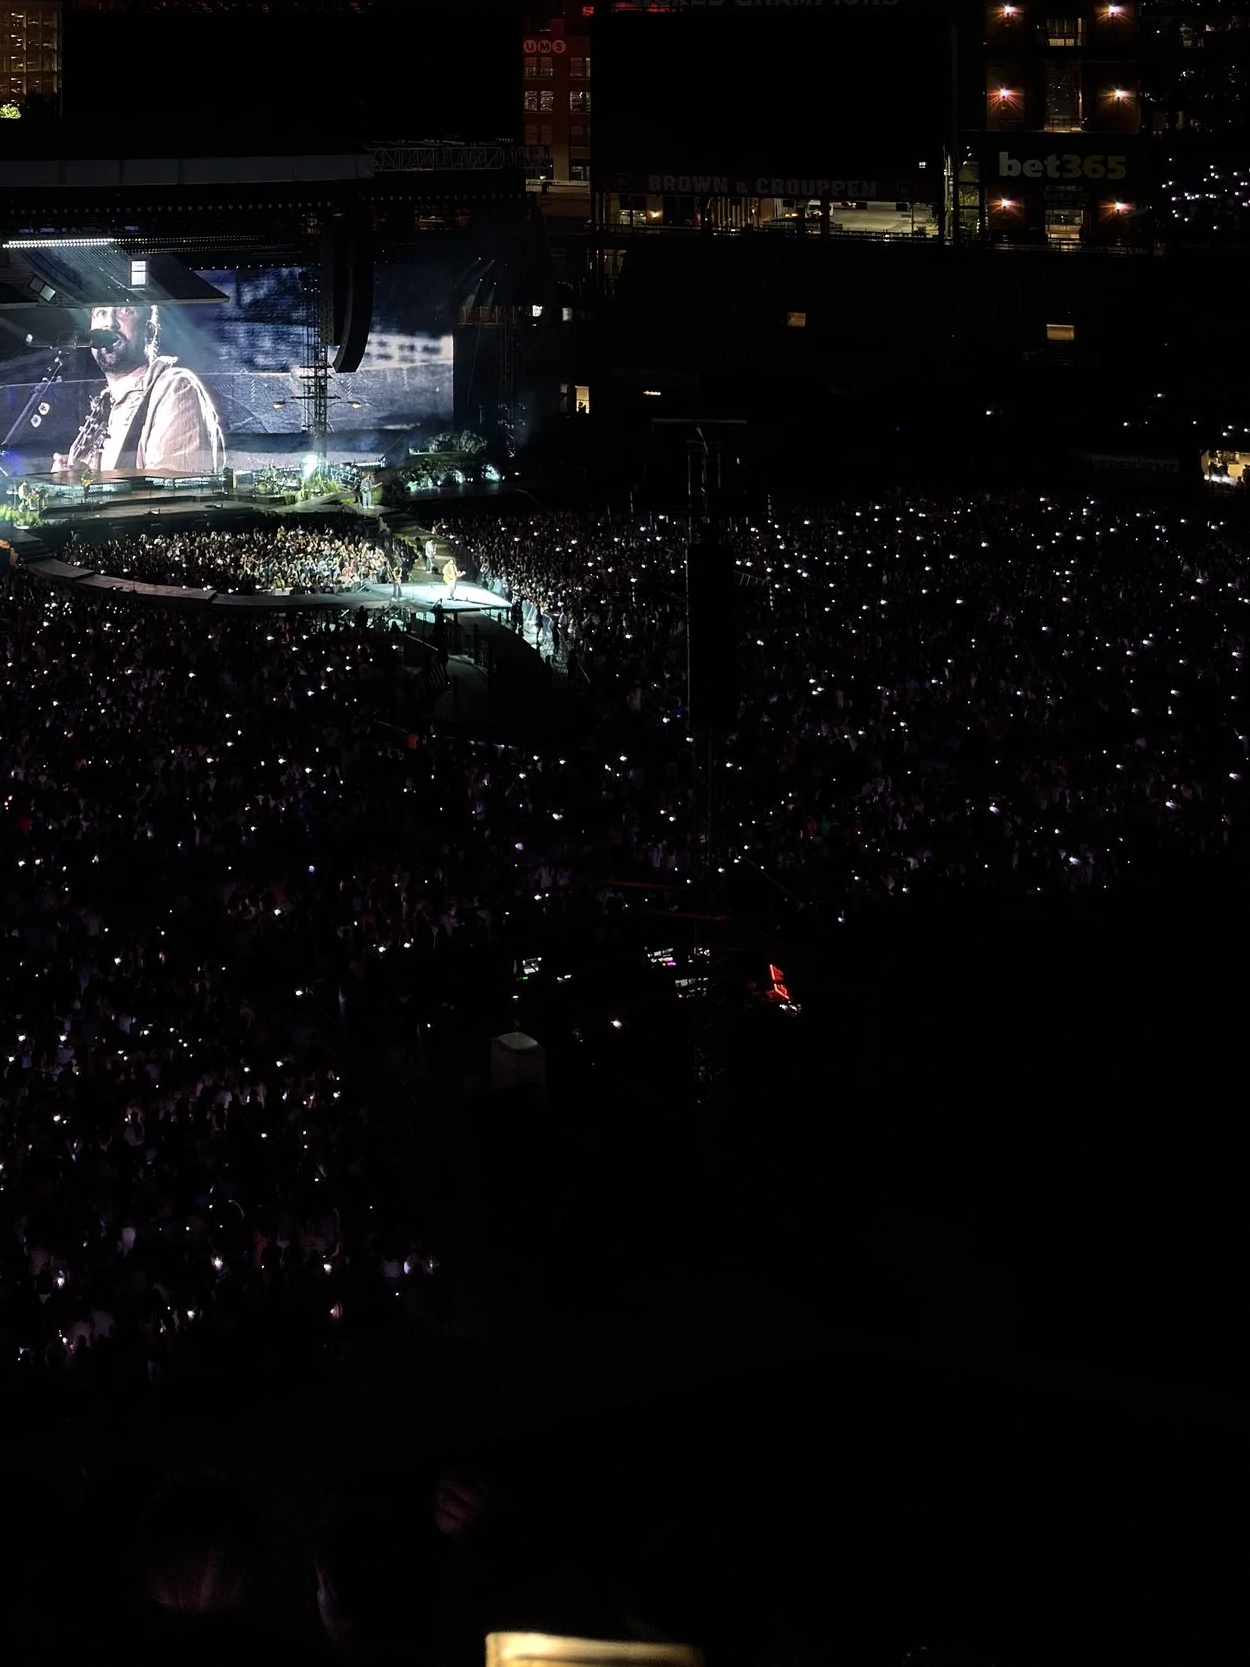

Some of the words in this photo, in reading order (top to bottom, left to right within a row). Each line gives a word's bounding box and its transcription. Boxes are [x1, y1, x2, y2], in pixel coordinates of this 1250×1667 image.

[999, 150, 1127, 180] bet365
[647, 173, 729, 193] BROWN
[755, 176, 878, 197] CROUPPEN
